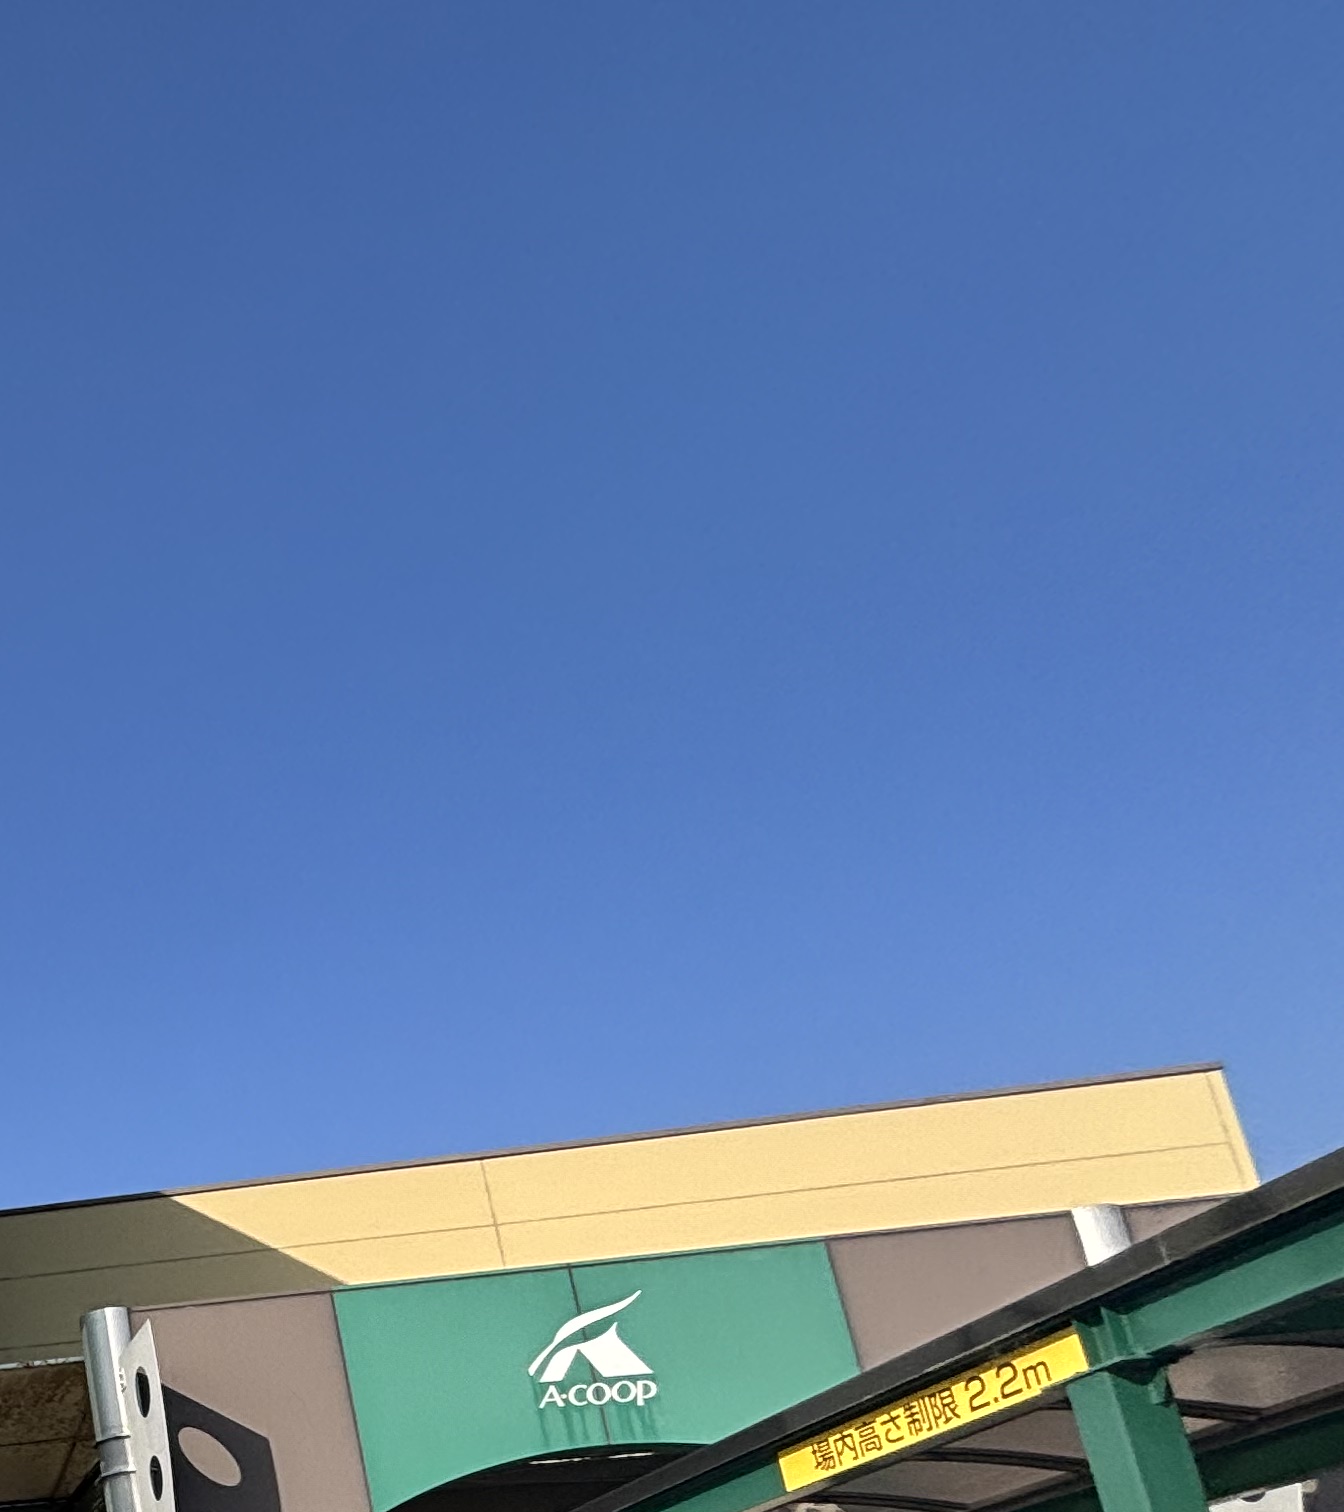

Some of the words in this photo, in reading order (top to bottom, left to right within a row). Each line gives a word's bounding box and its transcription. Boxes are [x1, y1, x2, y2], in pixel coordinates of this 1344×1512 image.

[812, 1387, 961, 1471] 場内高さ制限
[964, 1360, 1052, 1412] 2.2m
